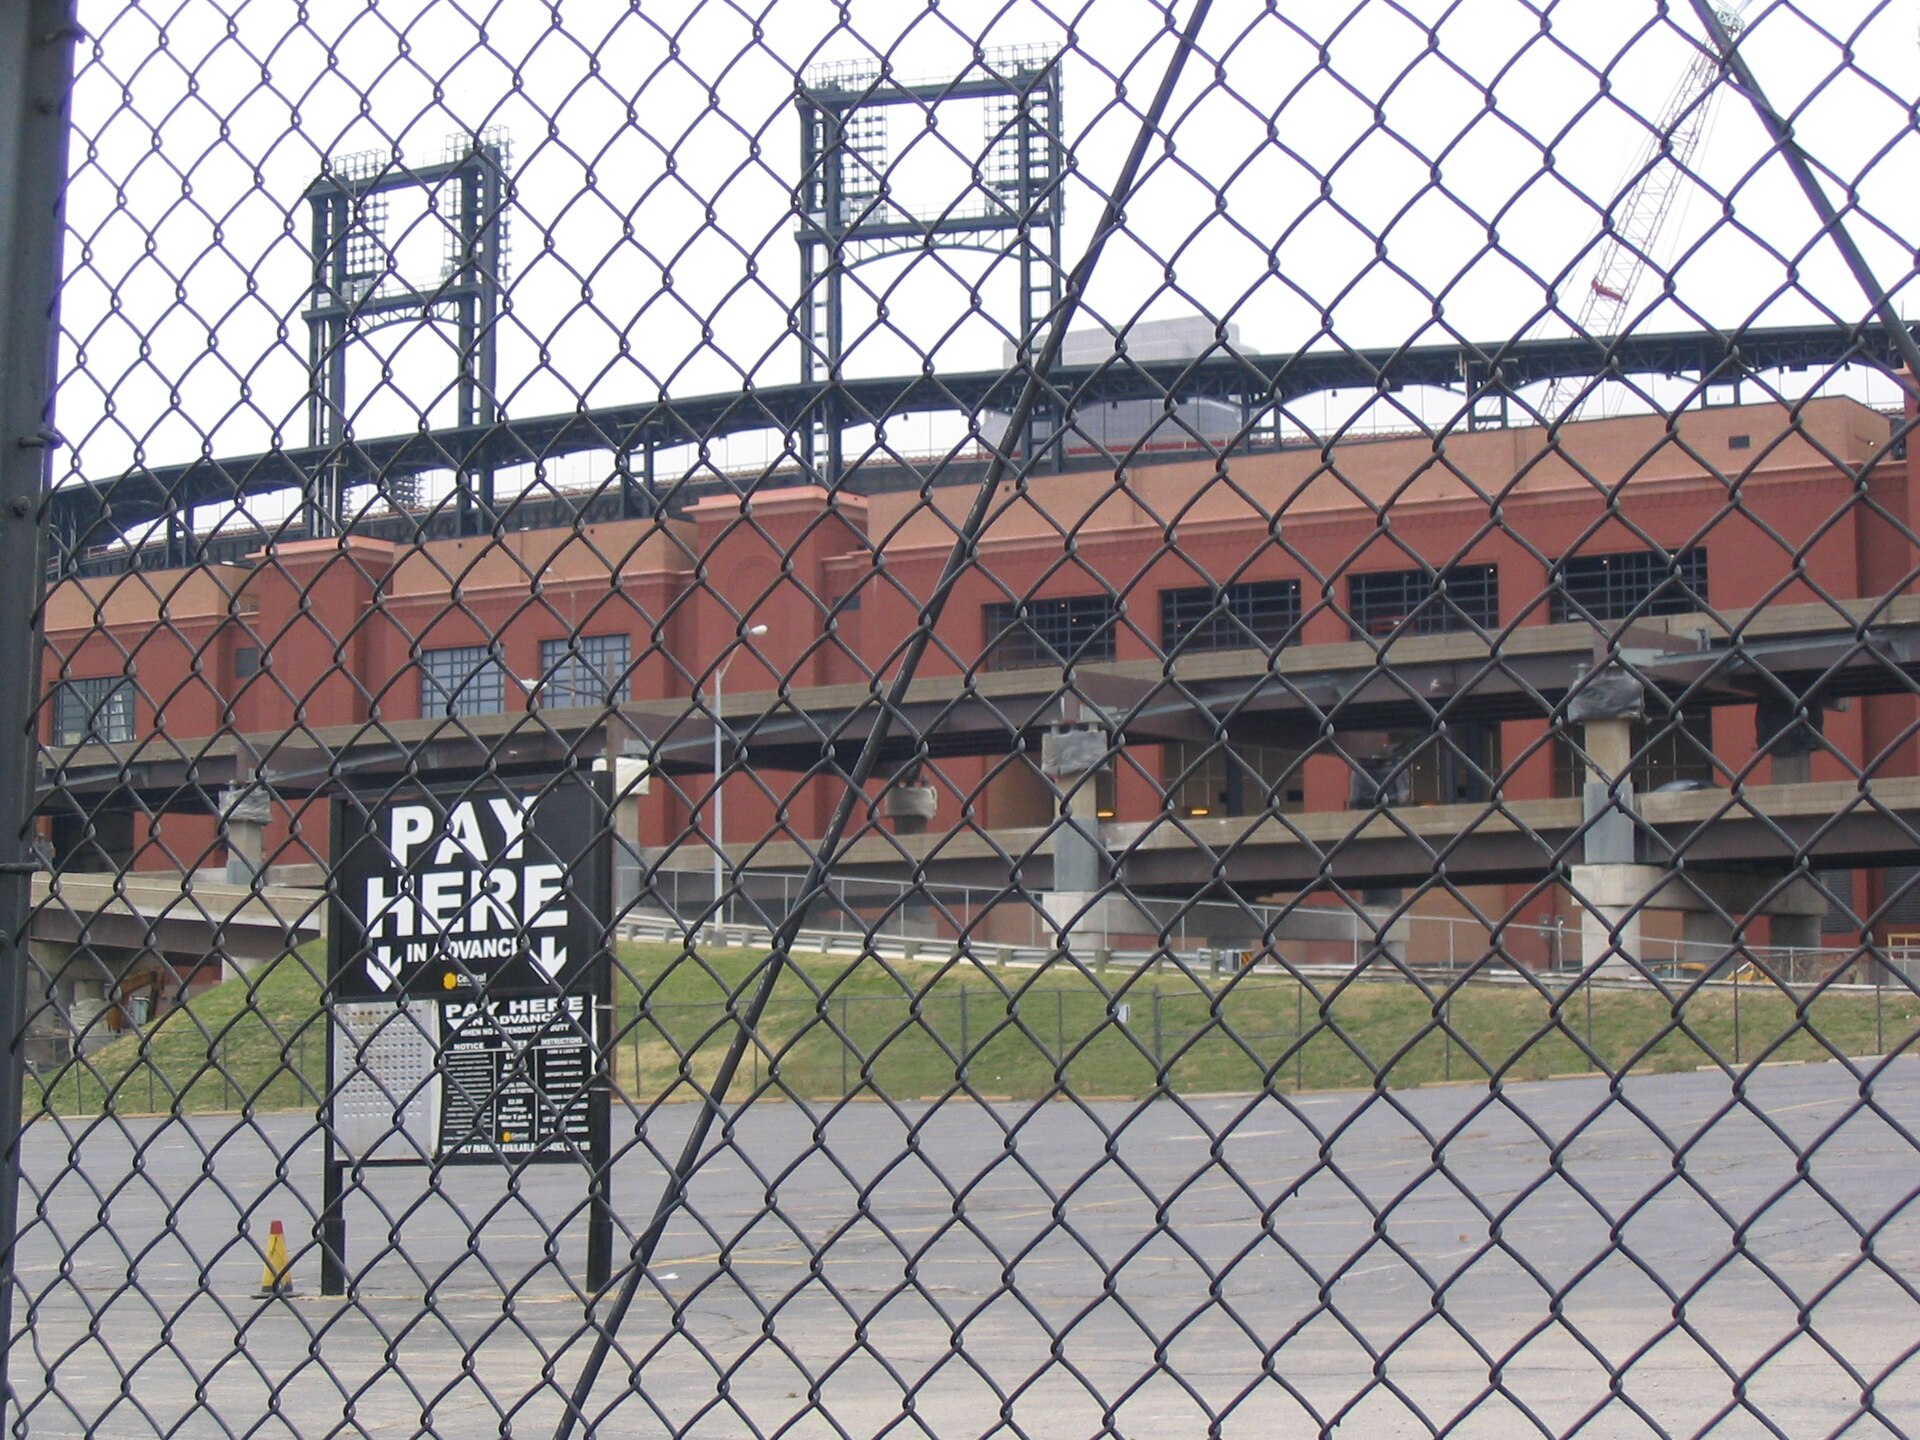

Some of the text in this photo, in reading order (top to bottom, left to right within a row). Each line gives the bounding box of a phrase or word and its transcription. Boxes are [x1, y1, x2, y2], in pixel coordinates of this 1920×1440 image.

[391, 796, 539, 868] PAY
[367, 864, 569, 938] HERE
[407, 943, 427, 962] IN
[457, 973, 487, 983] Ceral
[445, 1002, 500, 1018] PAY
[488, 1014, 563, 1026] DVANC
[495, 1025, 536, 1035] ATENDANT
[453, 1042, 485, 1050] NOTICE
[541, 1036, 583, 1047] INSTRUCTIONS
